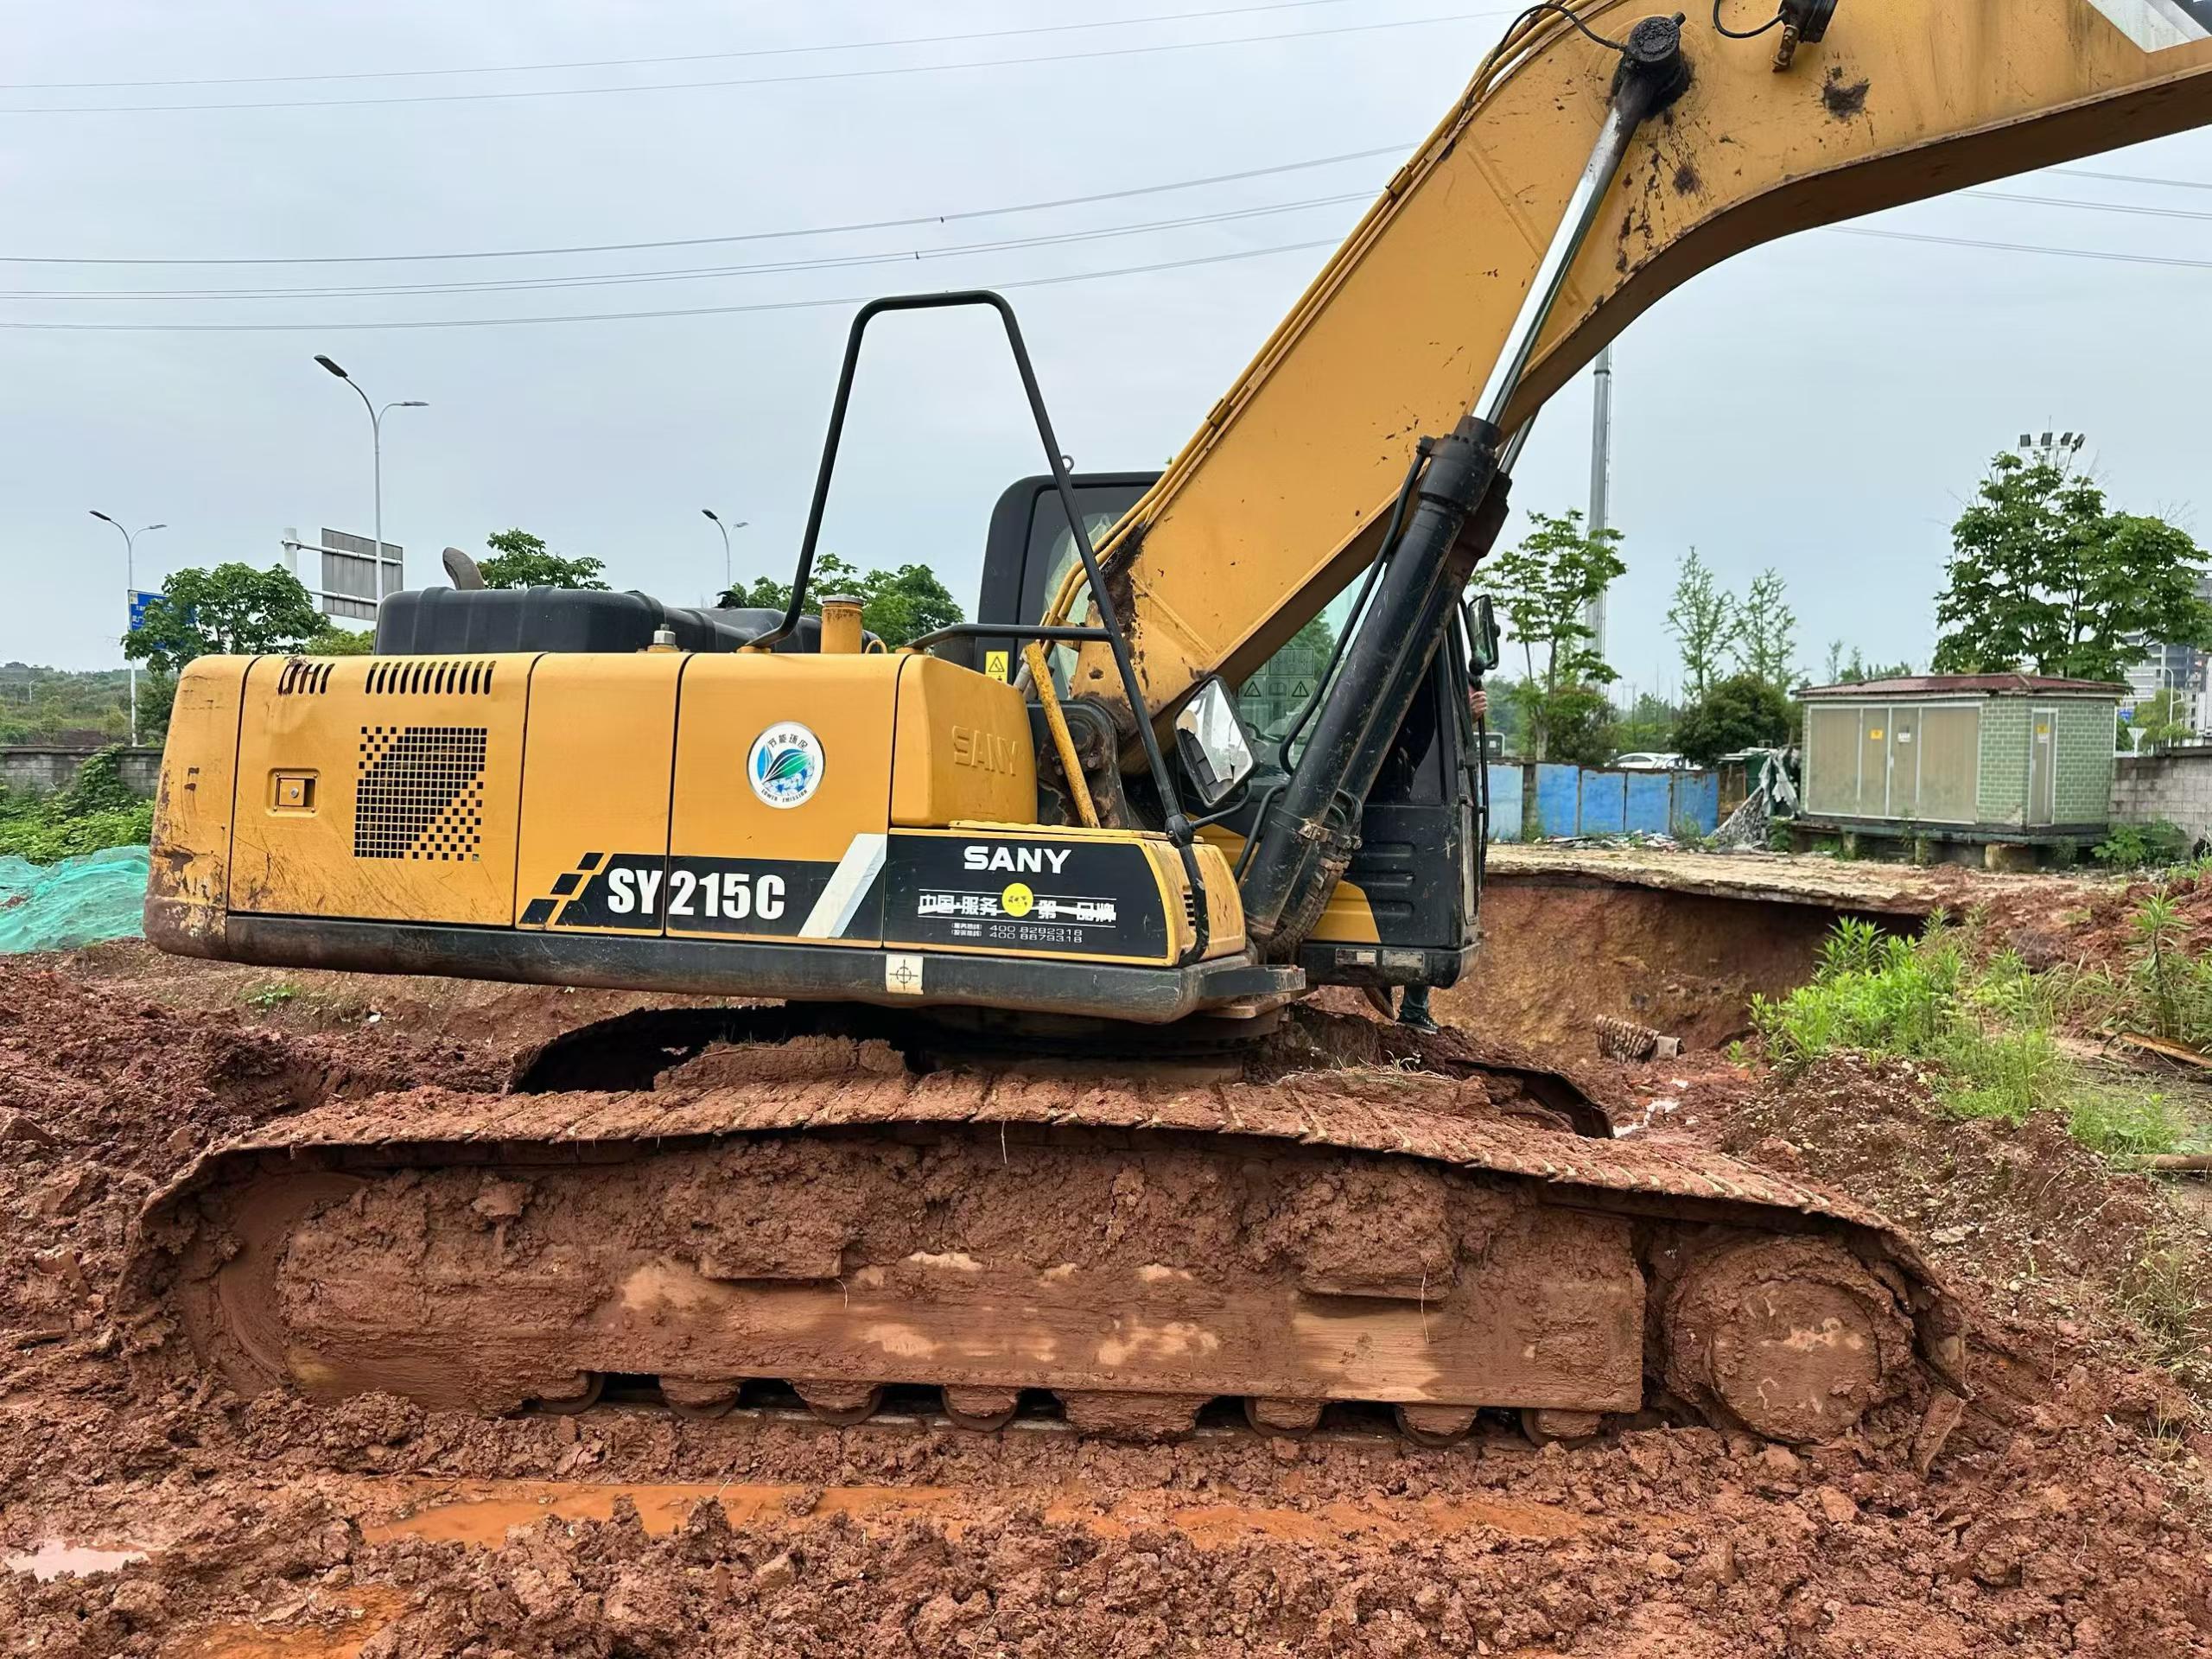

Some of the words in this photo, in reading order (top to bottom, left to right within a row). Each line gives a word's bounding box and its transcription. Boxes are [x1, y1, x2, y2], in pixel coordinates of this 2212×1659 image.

[952, 725, 1017, 777] SANY
[963, 845, 1072, 874] SANY
[1020, 926, 1083, 937] 8282318
